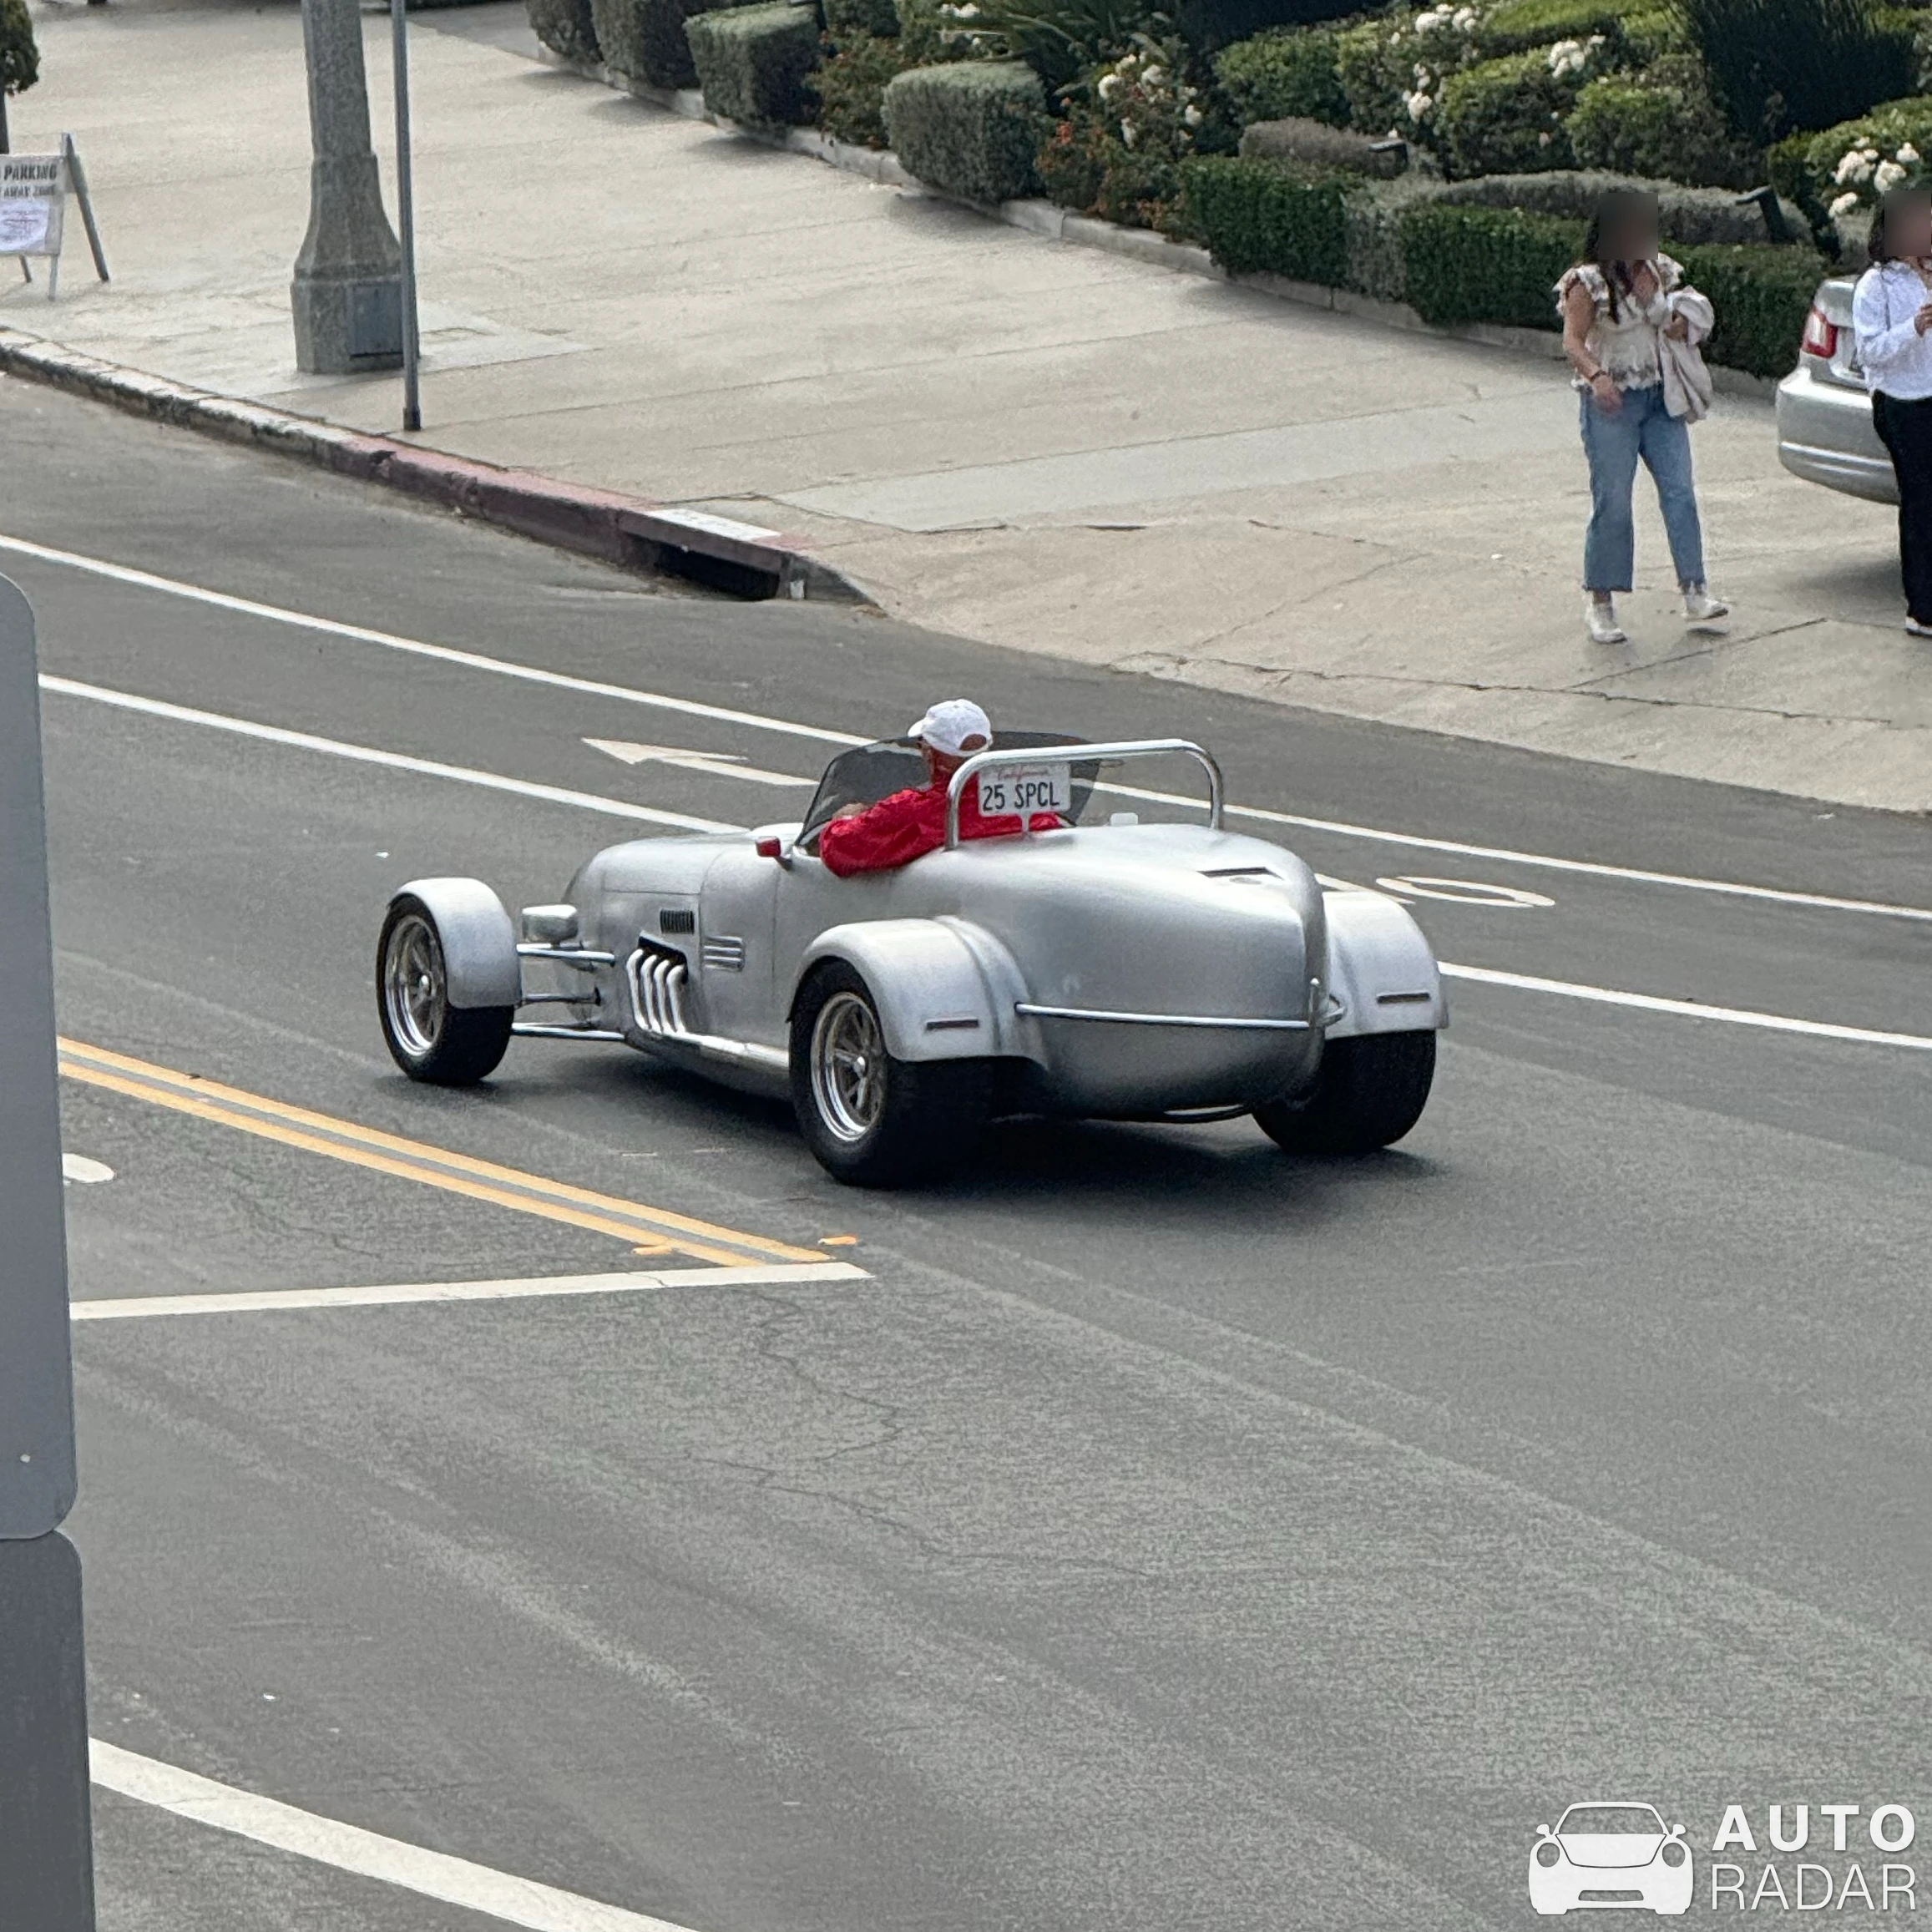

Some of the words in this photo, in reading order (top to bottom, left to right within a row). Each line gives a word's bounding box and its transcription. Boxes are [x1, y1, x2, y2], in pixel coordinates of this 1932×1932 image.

[3, 164, 57, 180] PARKING
[983, 784, 1005, 812] 25
[1014, 781, 1060, 809] SPCL
